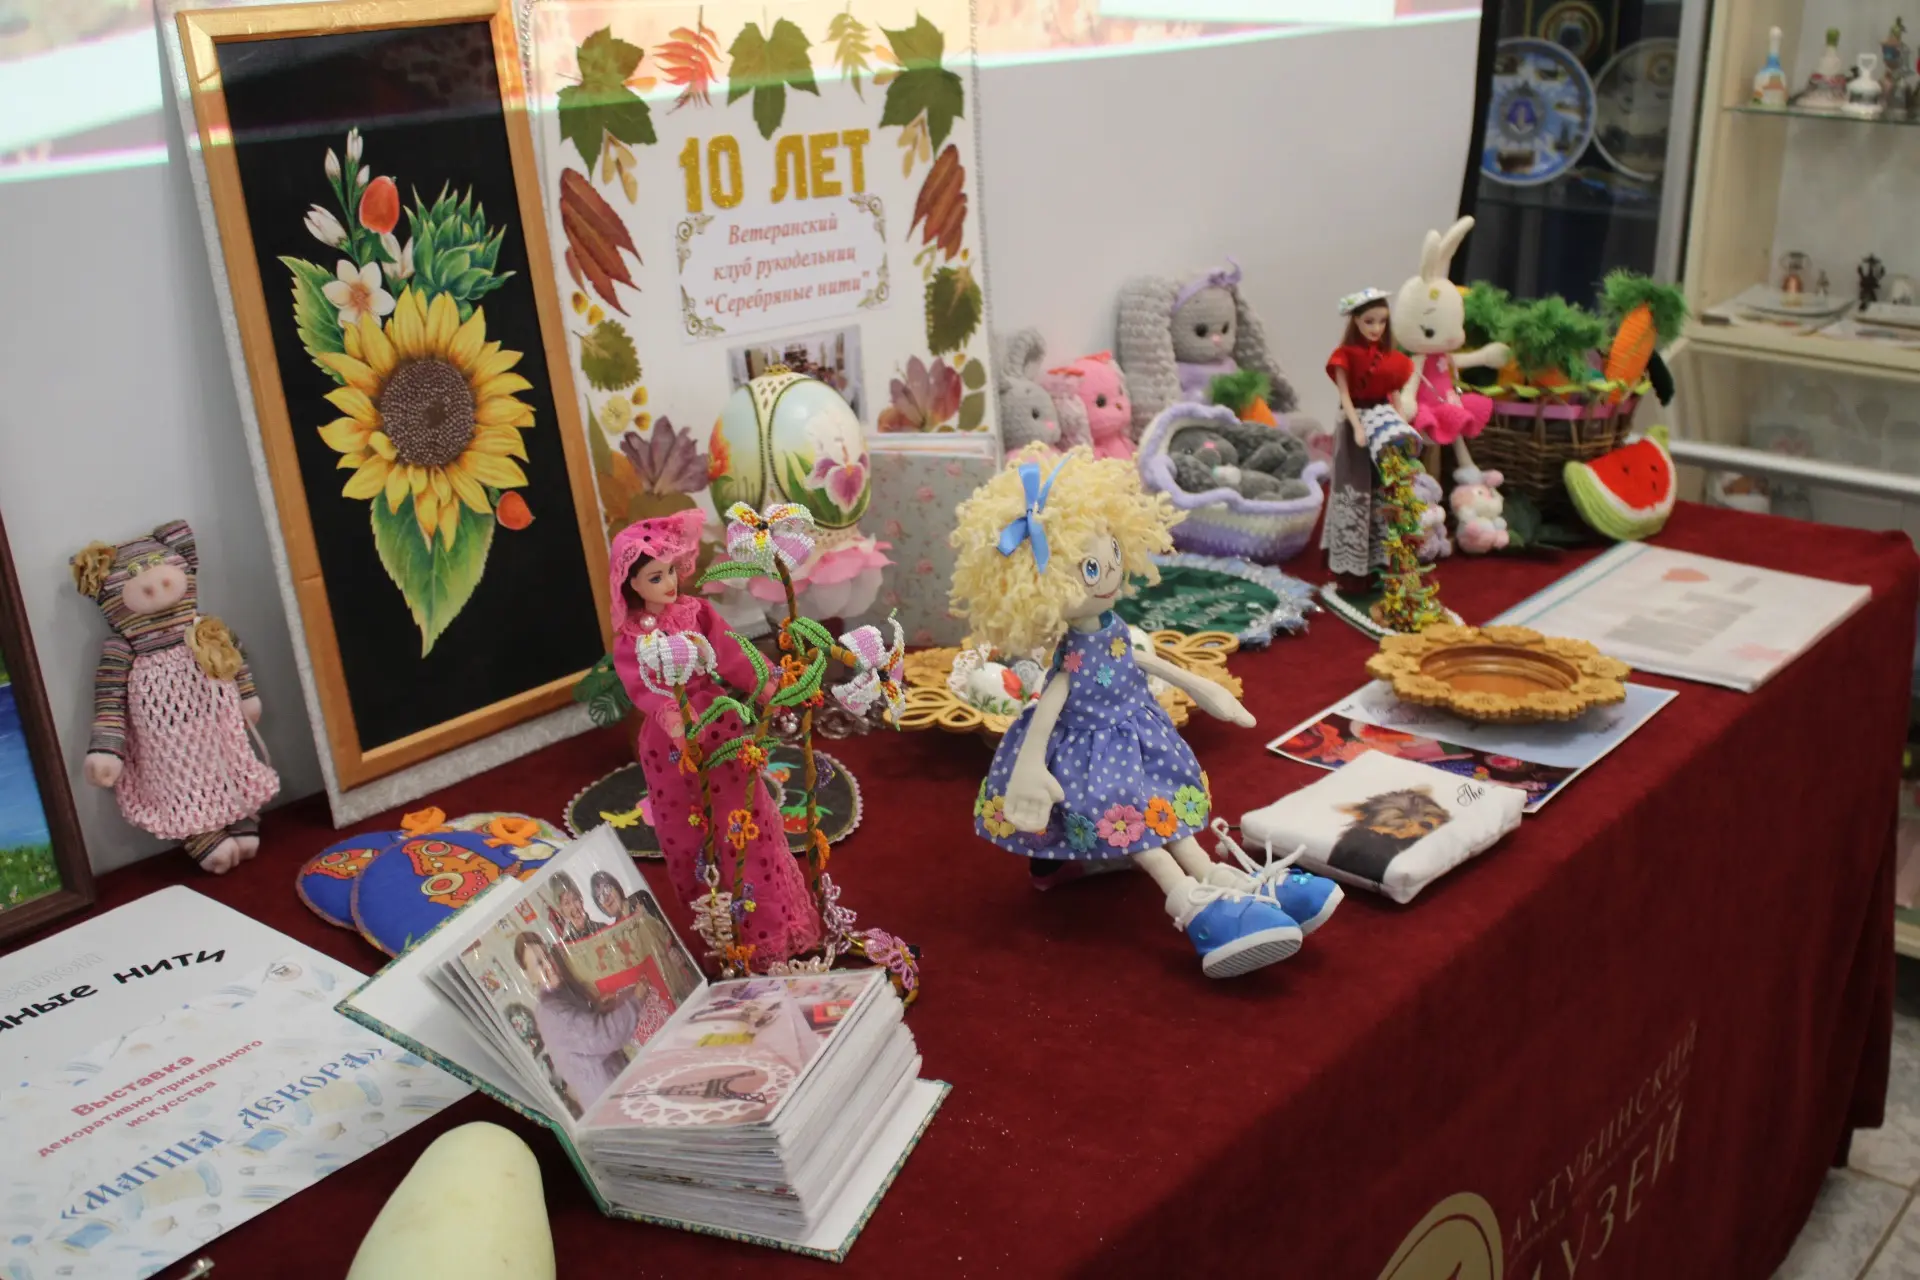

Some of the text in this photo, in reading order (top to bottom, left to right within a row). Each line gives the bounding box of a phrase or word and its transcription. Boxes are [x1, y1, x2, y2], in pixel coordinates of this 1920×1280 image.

[679, 128, 870, 213] 10 ЛЕТ
[728, 212, 838, 245] Ветеранский
[713, 247, 857, 284] клуб рукодельниц
[1456, 783, 1485, 807] The
[71, 1056, 195, 1117] Выставка
[126, 1080, 218, 1128] искусства
[1508, 1019, 1698, 1255] АХТУБИНСКИЙ
[1532, 1091, 1683, 1280] УЗЕЙ
